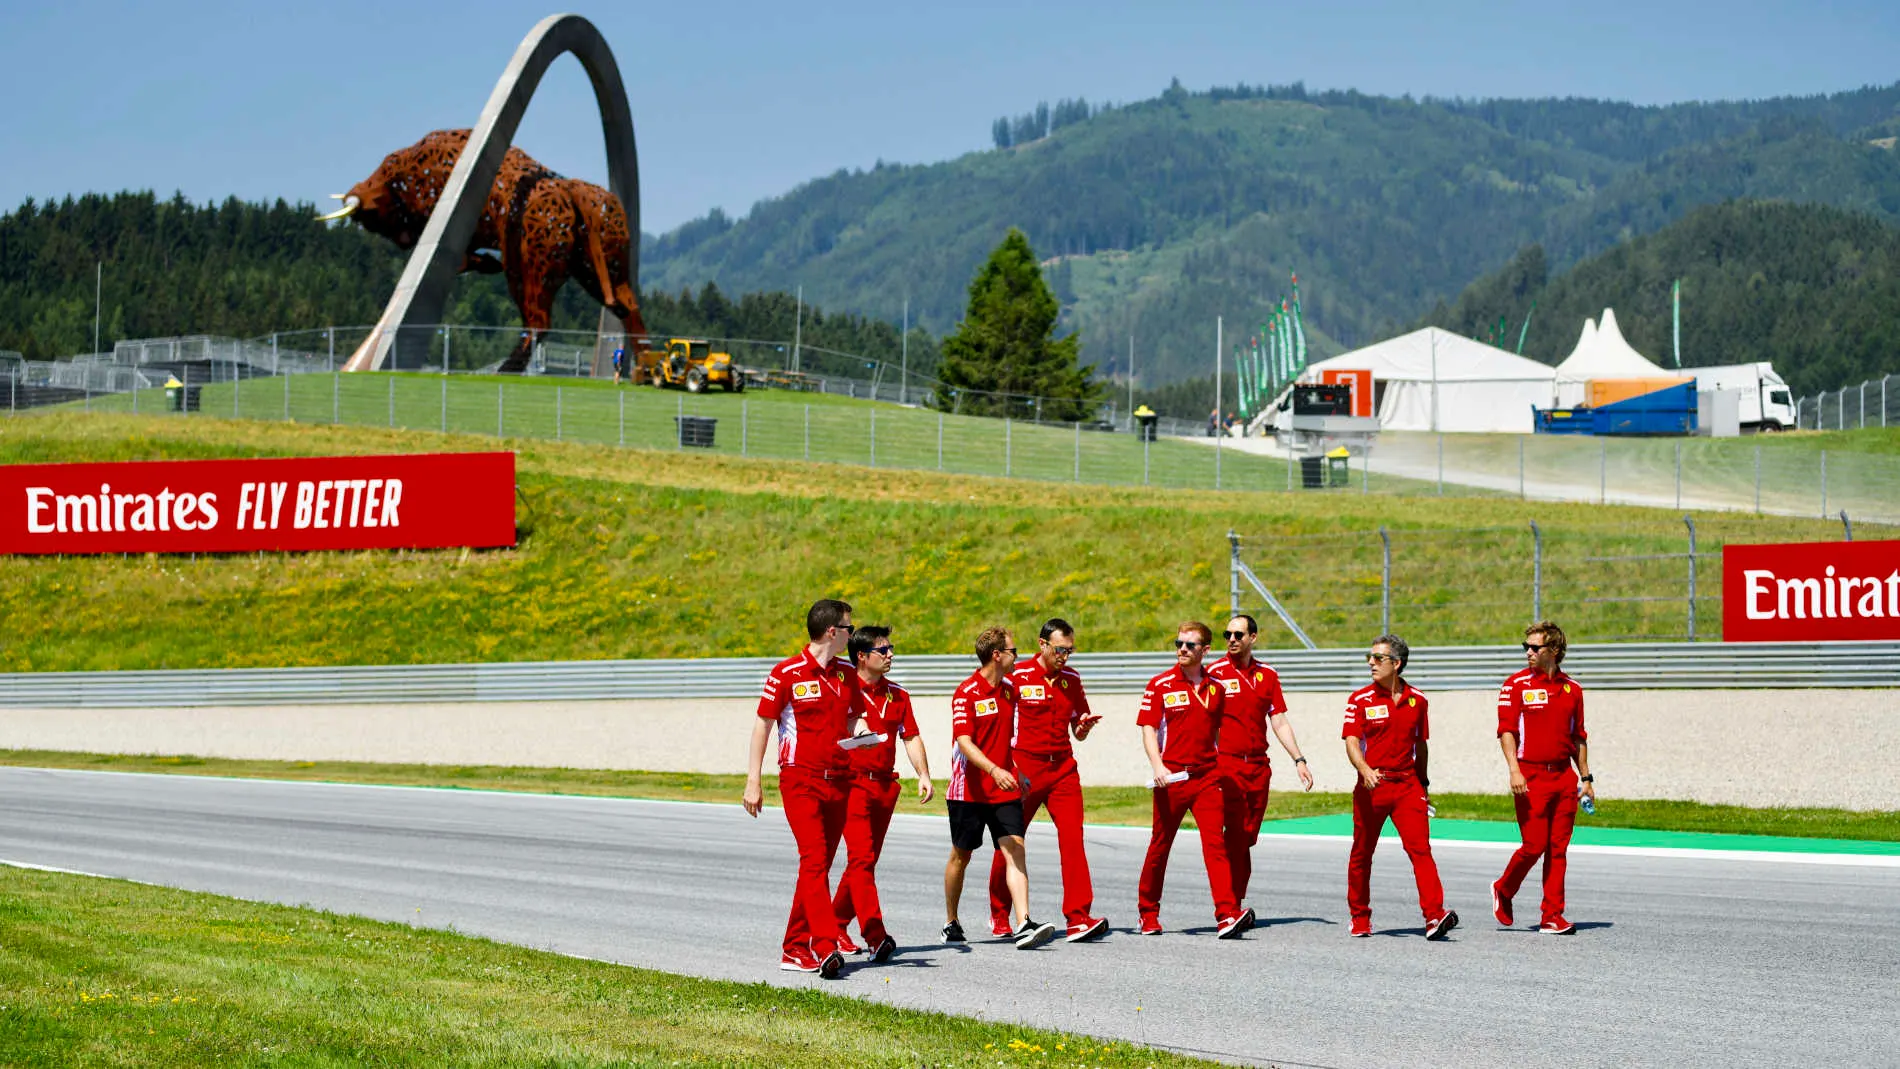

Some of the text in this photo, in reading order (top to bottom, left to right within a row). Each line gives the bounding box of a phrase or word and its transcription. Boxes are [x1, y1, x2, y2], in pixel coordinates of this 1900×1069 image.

[25, 478, 403, 534] Emirates FLY BETTER
